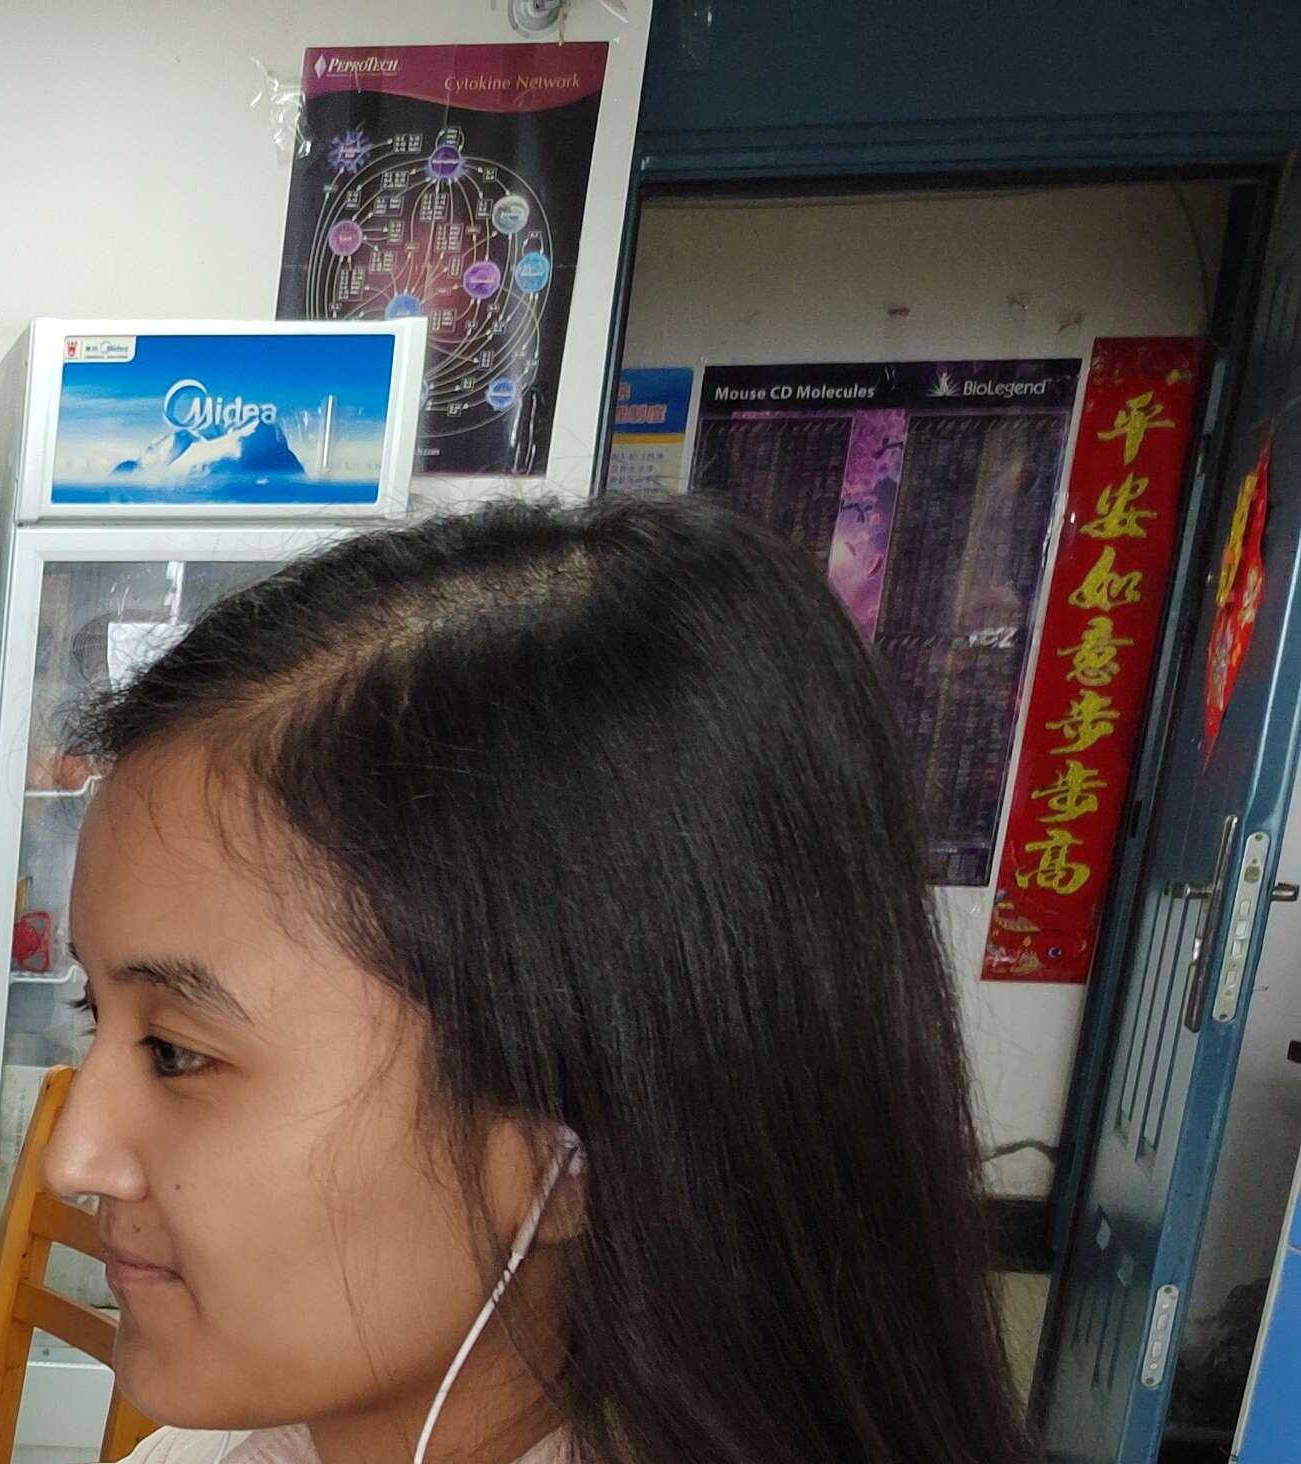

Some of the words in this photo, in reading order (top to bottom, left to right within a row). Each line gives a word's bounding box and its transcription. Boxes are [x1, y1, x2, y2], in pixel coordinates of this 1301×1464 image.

[444, 76, 511, 92] Cytokine
[516, 73, 581, 90] Network
[714, 386, 766, 401] Mouse
[770, 386, 793, 400] CD
[796, 384, 876, 400] Molecules
[962, 379, 1047, 398] BioLegend
[163, 381, 278, 431] Midea
[1015, 390, 1176, 896] 平安如意步步高
